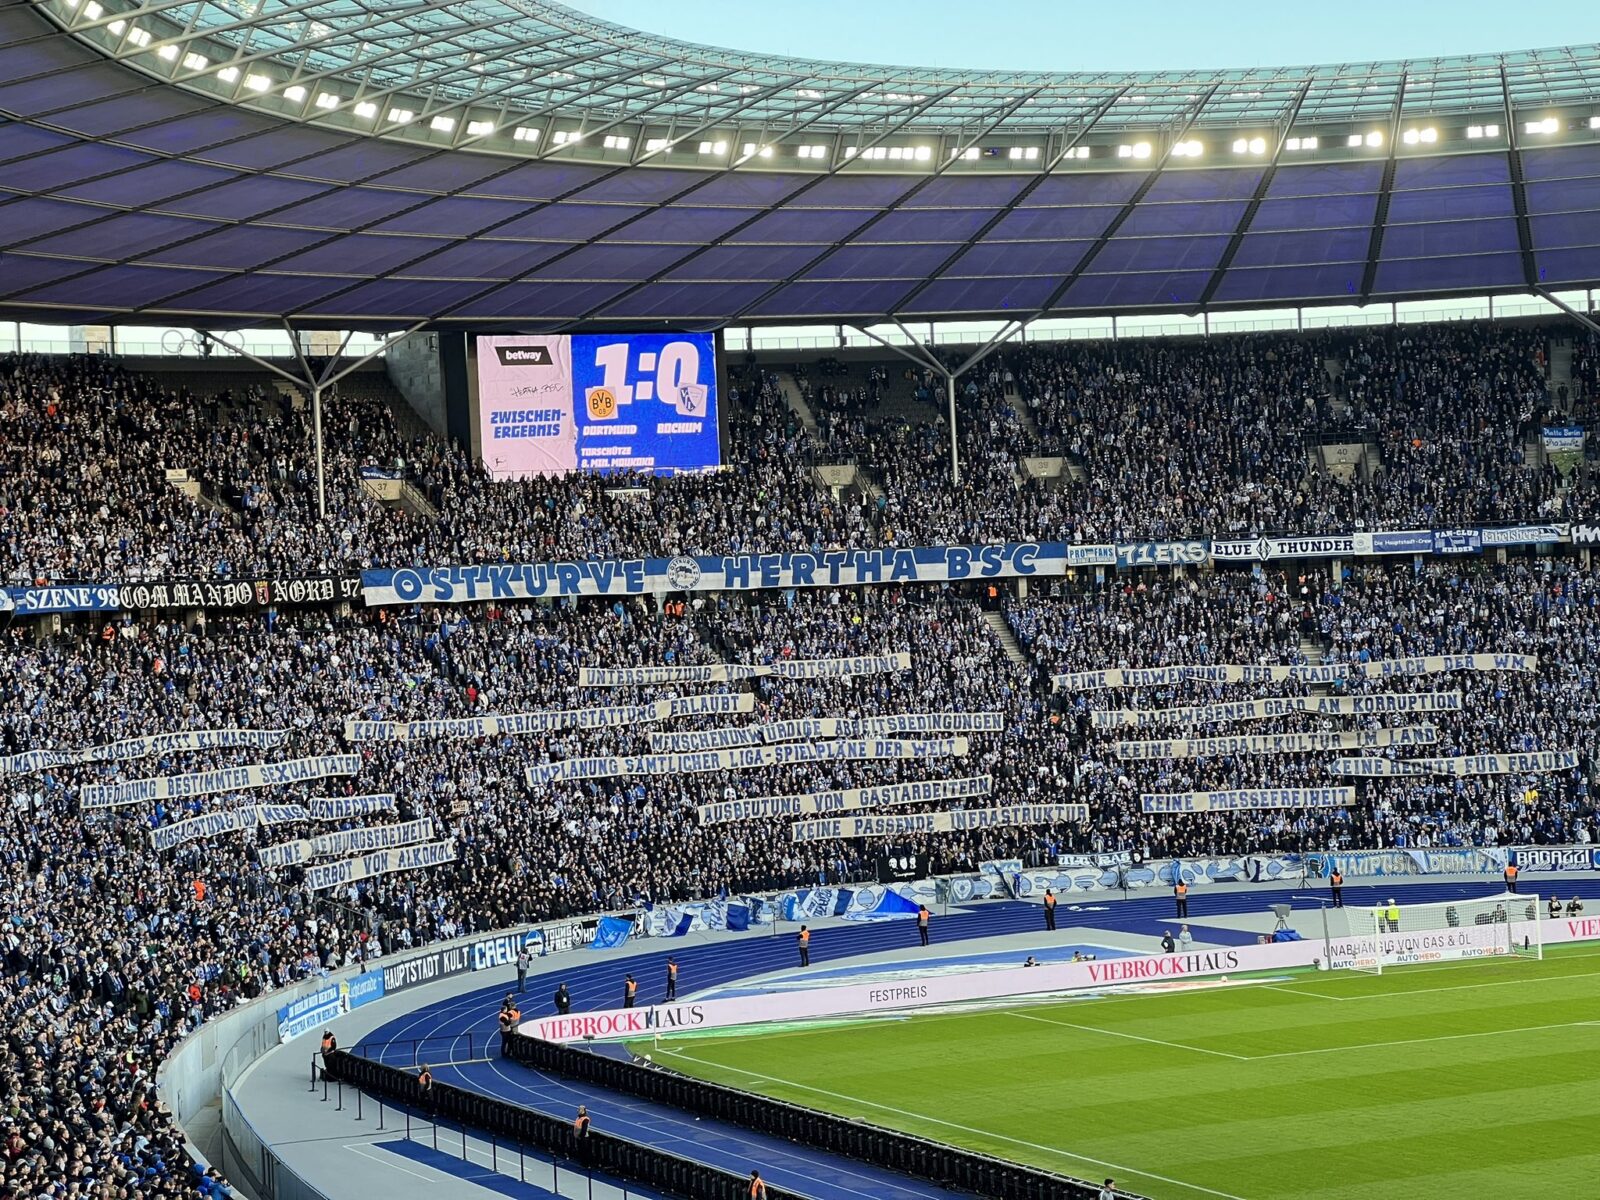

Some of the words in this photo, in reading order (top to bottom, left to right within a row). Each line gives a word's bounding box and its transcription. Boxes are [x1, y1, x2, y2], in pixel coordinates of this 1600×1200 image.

[505, 350, 542, 362] betway
[594, 341, 699, 405] 1:0
[490, 408, 566, 424] ZWISCHEN-
[657, 422, 702, 434] BOCHUM
[494, 423, 560, 439] ERGEBNIS
[583, 425, 637, 436] DORTMUND
[581, 446, 632, 456] TORSCHÜTZE
[591, 459, 610, 468] MIN.
[611, 457, 654, 468] MOUKOKO
[377, 483, 387, 491] 37
[1435, 530, 1478, 538] FAN-CLUB
[1094, 548, 1113, 558] FANS
[1118, 542, 1208, 566] 71ERS
[1214, 543, 1251, 556] BLUE
[1278, 540, 1354, 553] THUNDER
[722, 547, 918, 589] HERTHA
[946, 544, 1040, 578] BSC
[392, 559, 645, 601] OSTKURVE
[120, 582, 252, 609] COMMANDO
[271, 579, 335, 604] NORD
[587, 667, 712, 685] UNTERSTÜTZUNG
[770, 656, 899, 678] SPORTSWASHING
[1121, 667, 1227, 686] VERWENDUNG
[1243, 667, 1272, 682] DER
[1382, 659, 1425, 675] NACH
[1444, 655, 1475, 670] DER
[1494, 654, 1526, 669] WM
[354, 722, 396, 740] KEINE
[408, 719, 484, 739] KRITISCHE
[496, 703, 656, 736] BERICHTERSTATTUNG
[670, 695, 739, 716] ERLAUBT
[1098, 712, 1124, 728] NIE
[1264, 698, 1306, 716] GRAD
[1317, 698, 1341, 713] AN
[1352, 694, 1459, 713] KORRUPTION
[835, 714, 1002, 738] ARBEITSBEDINGUNGEN
[152, 734, 190, 750] STATT
[1121, 741, 1173, 758] KEINE
[1187, 733, 1342, 757] FUSSBALLKULTUR
[1357, 730, 1377, 746] IM
[1390, 727, 1436, 744] LAND
[530, 757, 618, 785] UMPLANUNG
[875, 740, 904, 757] DER
[911, 740, 956, 757] WELT
[1331, 757, 1384, 775] KEINE
[1390, 759, 1455, 775] RECHTE
[1509, 752, 1576, 771] FRAUEN
[83, 780, 156, 807] VERFOLGUNG
[167, 767, 250, 795] BESTIMMTER
[262, 755, 361, 784] SEXUALITÄTEN
[704, 797, 800, 823] AUSBEUTUNG
[814, 793, 844, 811] VON
[860, 777, 989, 806] GASTARBEITERN
[1143, 794, 1194, 812] KEINE
[1209, 788, 1349, 810] PRESSEFREIHEIT
[155, 812, 234, 849] MISSACHTUNG
[233, 807, 257, 827] VON
[794, 819, 841, 841] KEINE
[854, 815, 935, 836] PASSENDE
[951, 804, 1087, 830] INFRASTRUKTUR
[262, 842, 302, 867] KEINE
[312, 821, 431, 855] MEINUNGSFREIHEIT
[307, 862, 352, 888] VERBOT
[364, 852, 389, 875] VON
[399, 843, 454, 868] ALKOHOL
[545, 926, 573, 940] YOUNG
[1568, 919, 1600, 937] VIE
[475, 935, 521, 969] CREW
[551, 938, 573, 951] FREE
[1323, 940, 1395, 958] UNABHÄNGIG
[1396, 938, 1420, 951] VON
[1423, 936, 1444, 949] GAS
[1447, 935, 1455, 947] &
[1458, 933, 1471, 946] ÖL
[1461, 946, 1504, 957] AUTOHERO
[384, 953, 439, 991] HAUPTSTADT
[444, 947, 470, 973] KULT
[1088, 951, 1239, 983] VIEBROCKHAUS
[1332, 958, 1376, 969] AUTOHERO
[1396, 952, 1441, 962] AUTOHERO
[870, 985, 927, 1003] FESTPREIS
[539, 1005, 704, 1040] VIEBROCKHAUS
